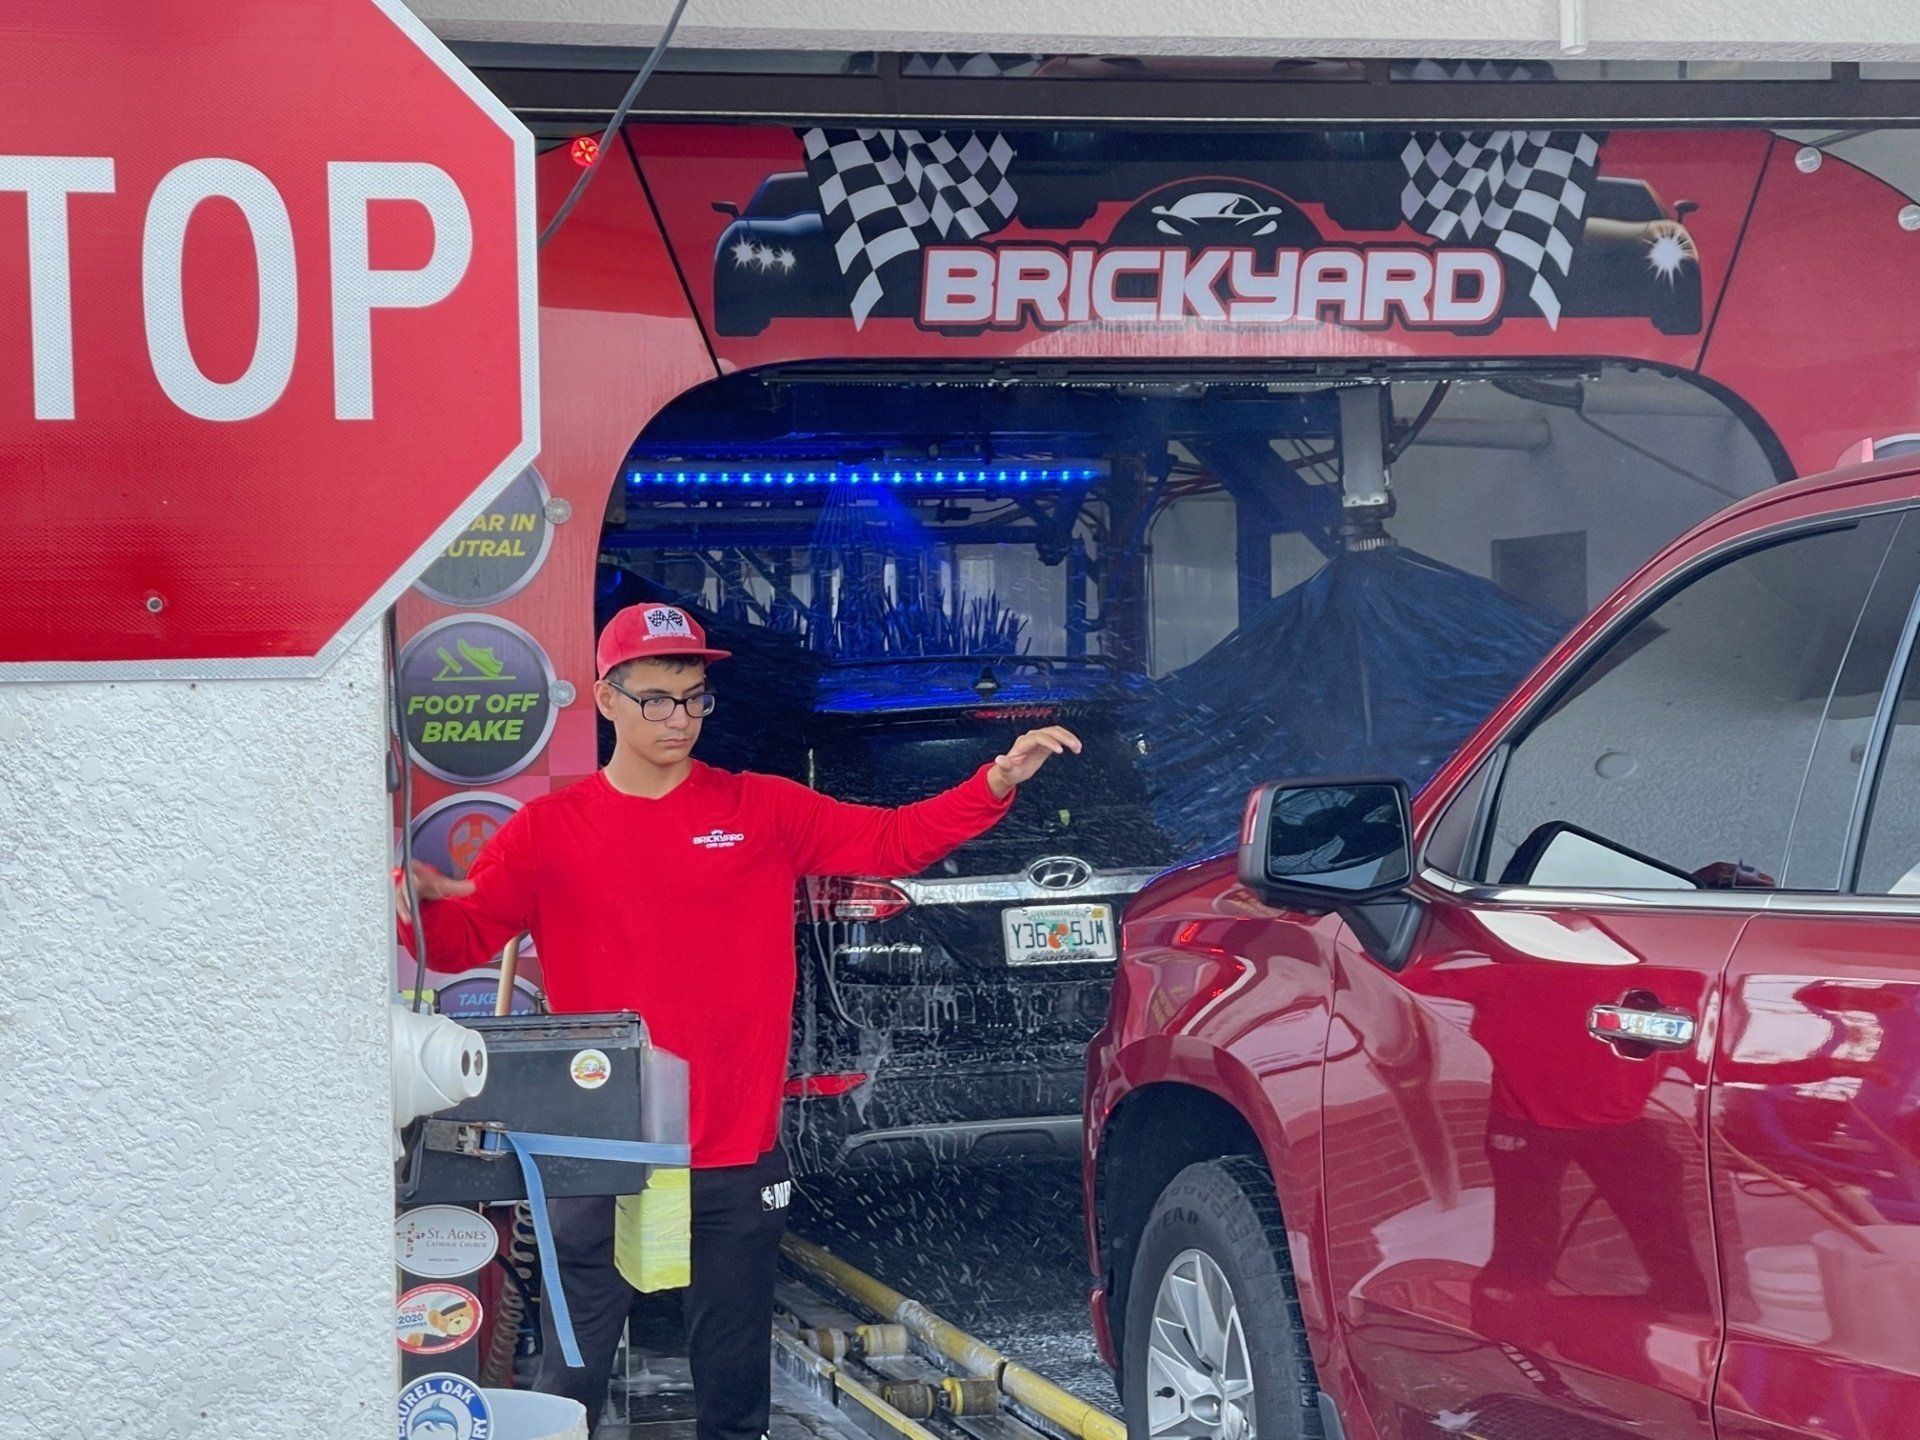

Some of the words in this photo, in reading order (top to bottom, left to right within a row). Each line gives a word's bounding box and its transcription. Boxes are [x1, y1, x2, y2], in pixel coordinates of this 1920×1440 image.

[0, 155, 473, 422] TOP
[921, 249, 1502, 323] BRICKYARD
[470, 515, 505, 531] AR
[509, 514, 536, 531] IN
[439, 540, 526, 557] UTRAL
[407, 695, 481, 715] FOOT
[485, 693, 540, 713] OFF
[421, 719, 525, 743] BRAKE
[693, 834, 744, 844] BRICKYARD
[1011, 922, 1048, 949] Y36
[459, 992, 497, 1006] TAKE
[447, 1228, 487, 1240] AGNES
[398, 1313, 424, 1325] 2020
[398, 1382, 437, 1438] LAUREL
[440, 1380, 475, 1405] OAK
